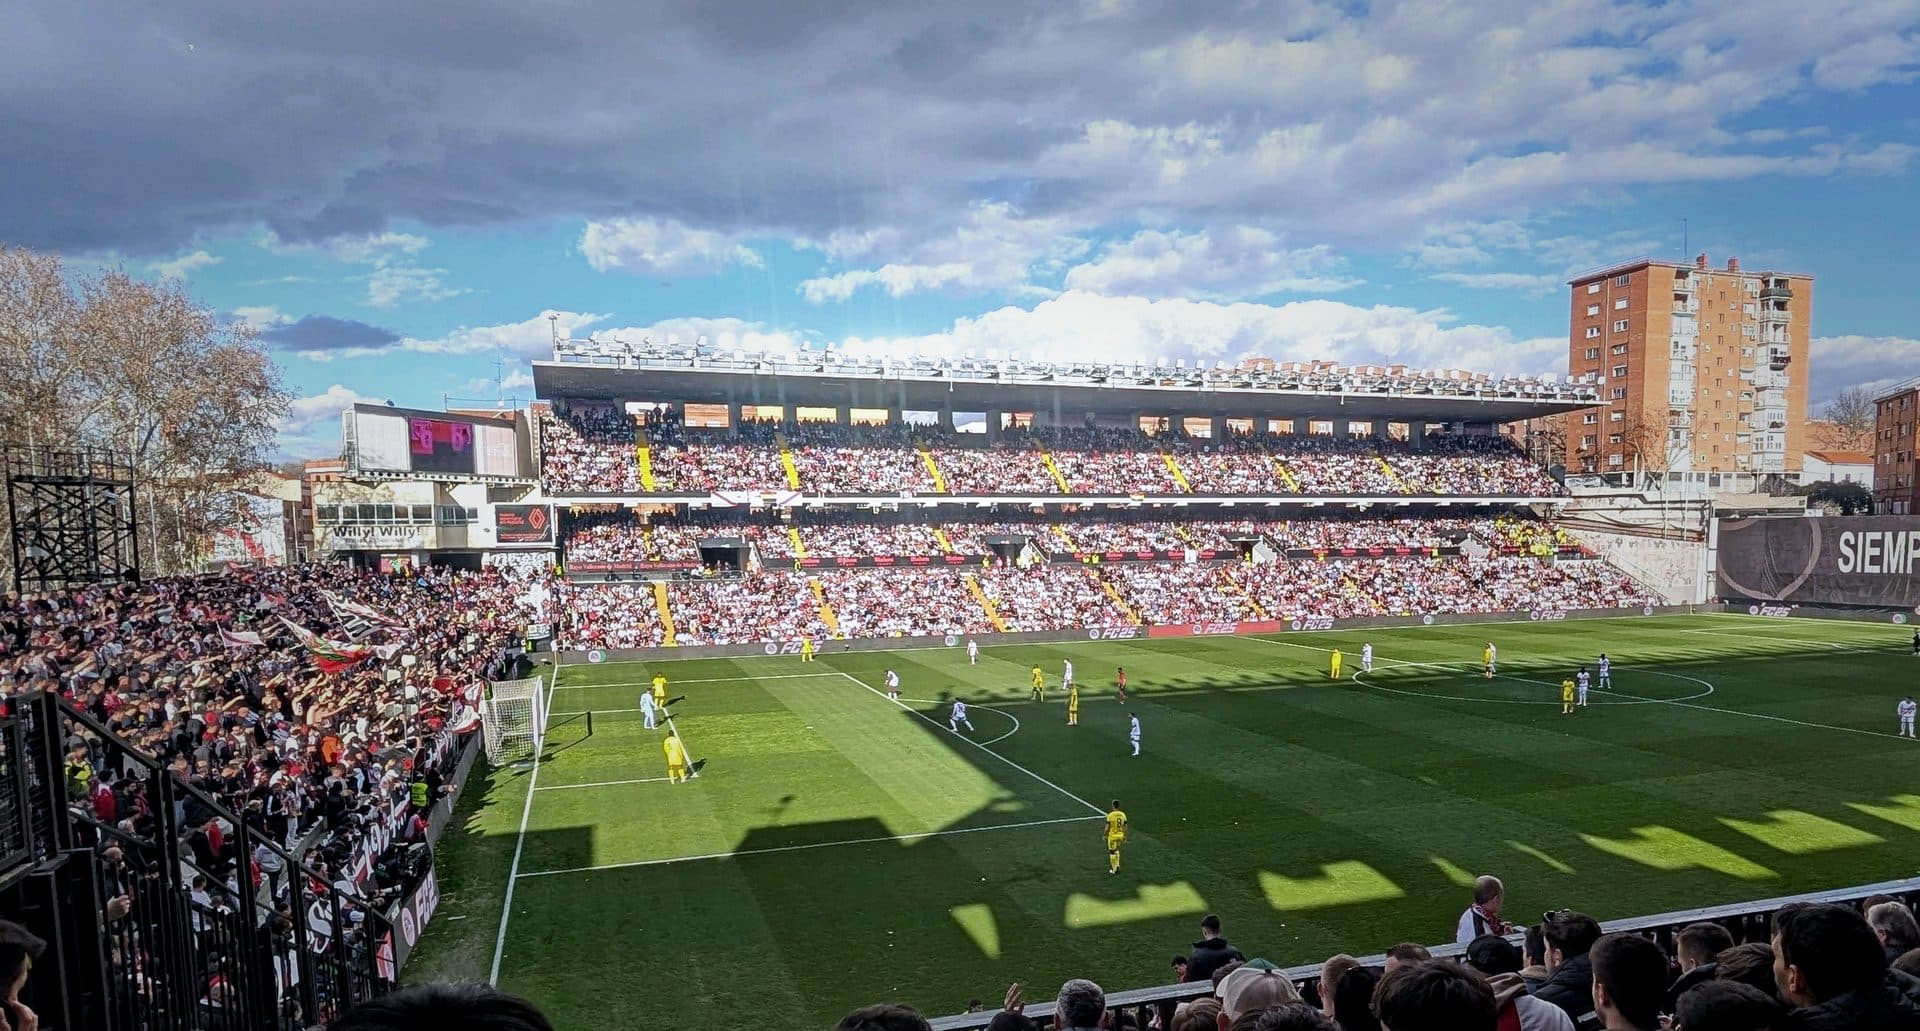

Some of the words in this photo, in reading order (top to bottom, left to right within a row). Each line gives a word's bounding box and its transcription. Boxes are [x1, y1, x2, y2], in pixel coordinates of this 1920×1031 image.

[333, 526, 374, 540] Willy!
[380, 526, 421, 539] Willy!
[1838, 531, 1920, 574] SIEMP
